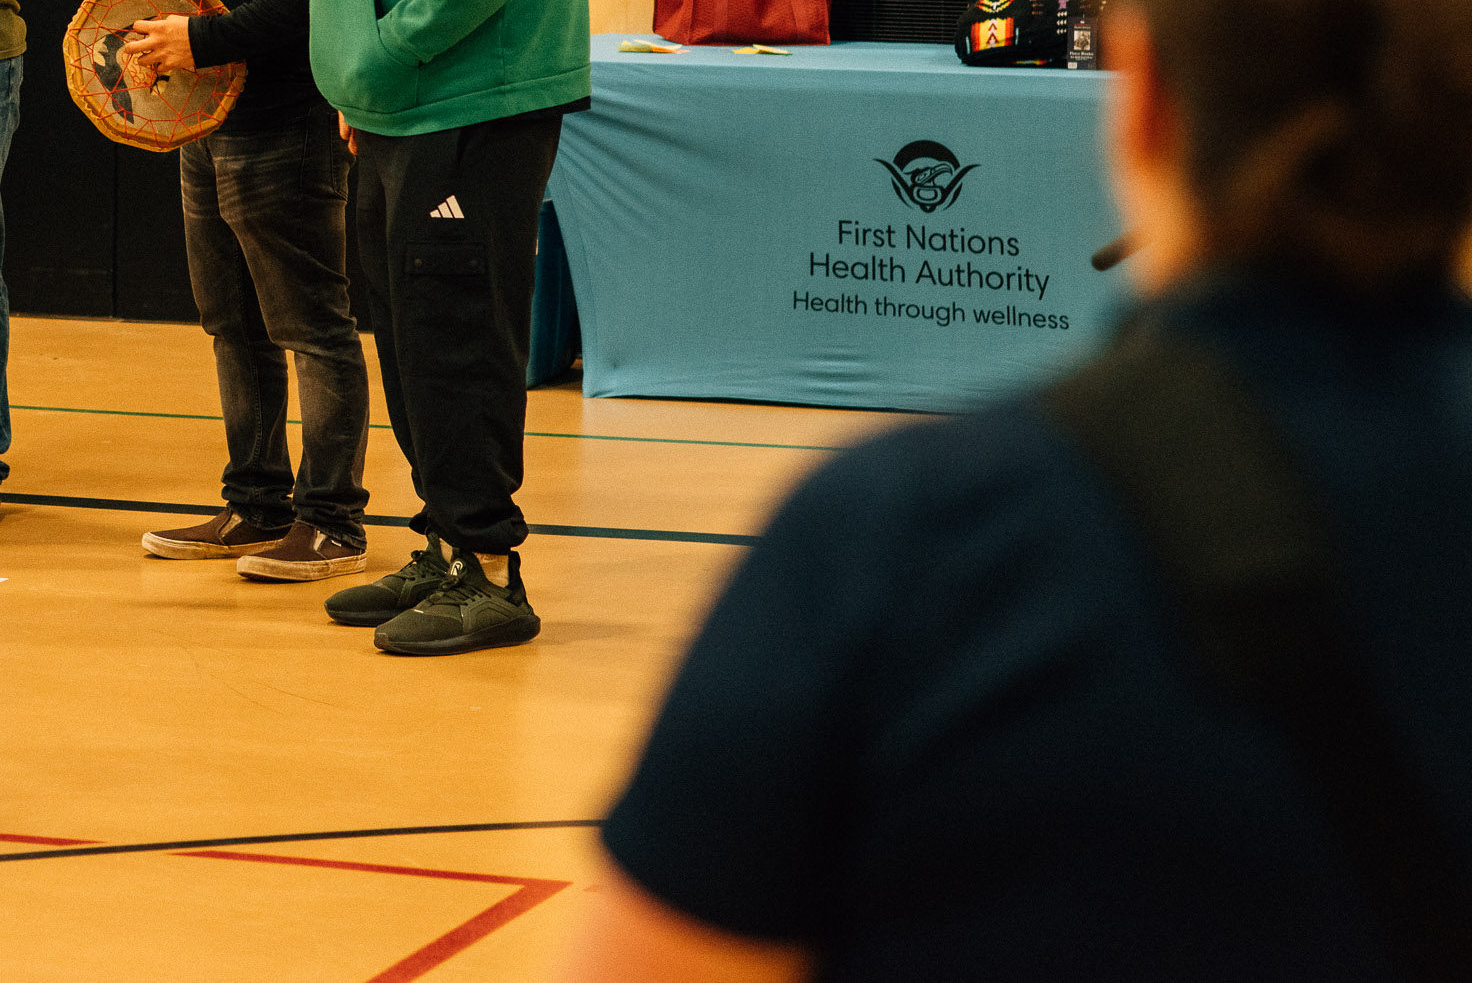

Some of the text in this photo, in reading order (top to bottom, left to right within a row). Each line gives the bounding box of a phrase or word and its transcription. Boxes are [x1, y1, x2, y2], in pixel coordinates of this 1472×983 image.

[838, 220, 1020, 256] First Nations
[809, 252, 1050, 300] Health Authority
[792, 291, 1070, 330] Health through wellness
